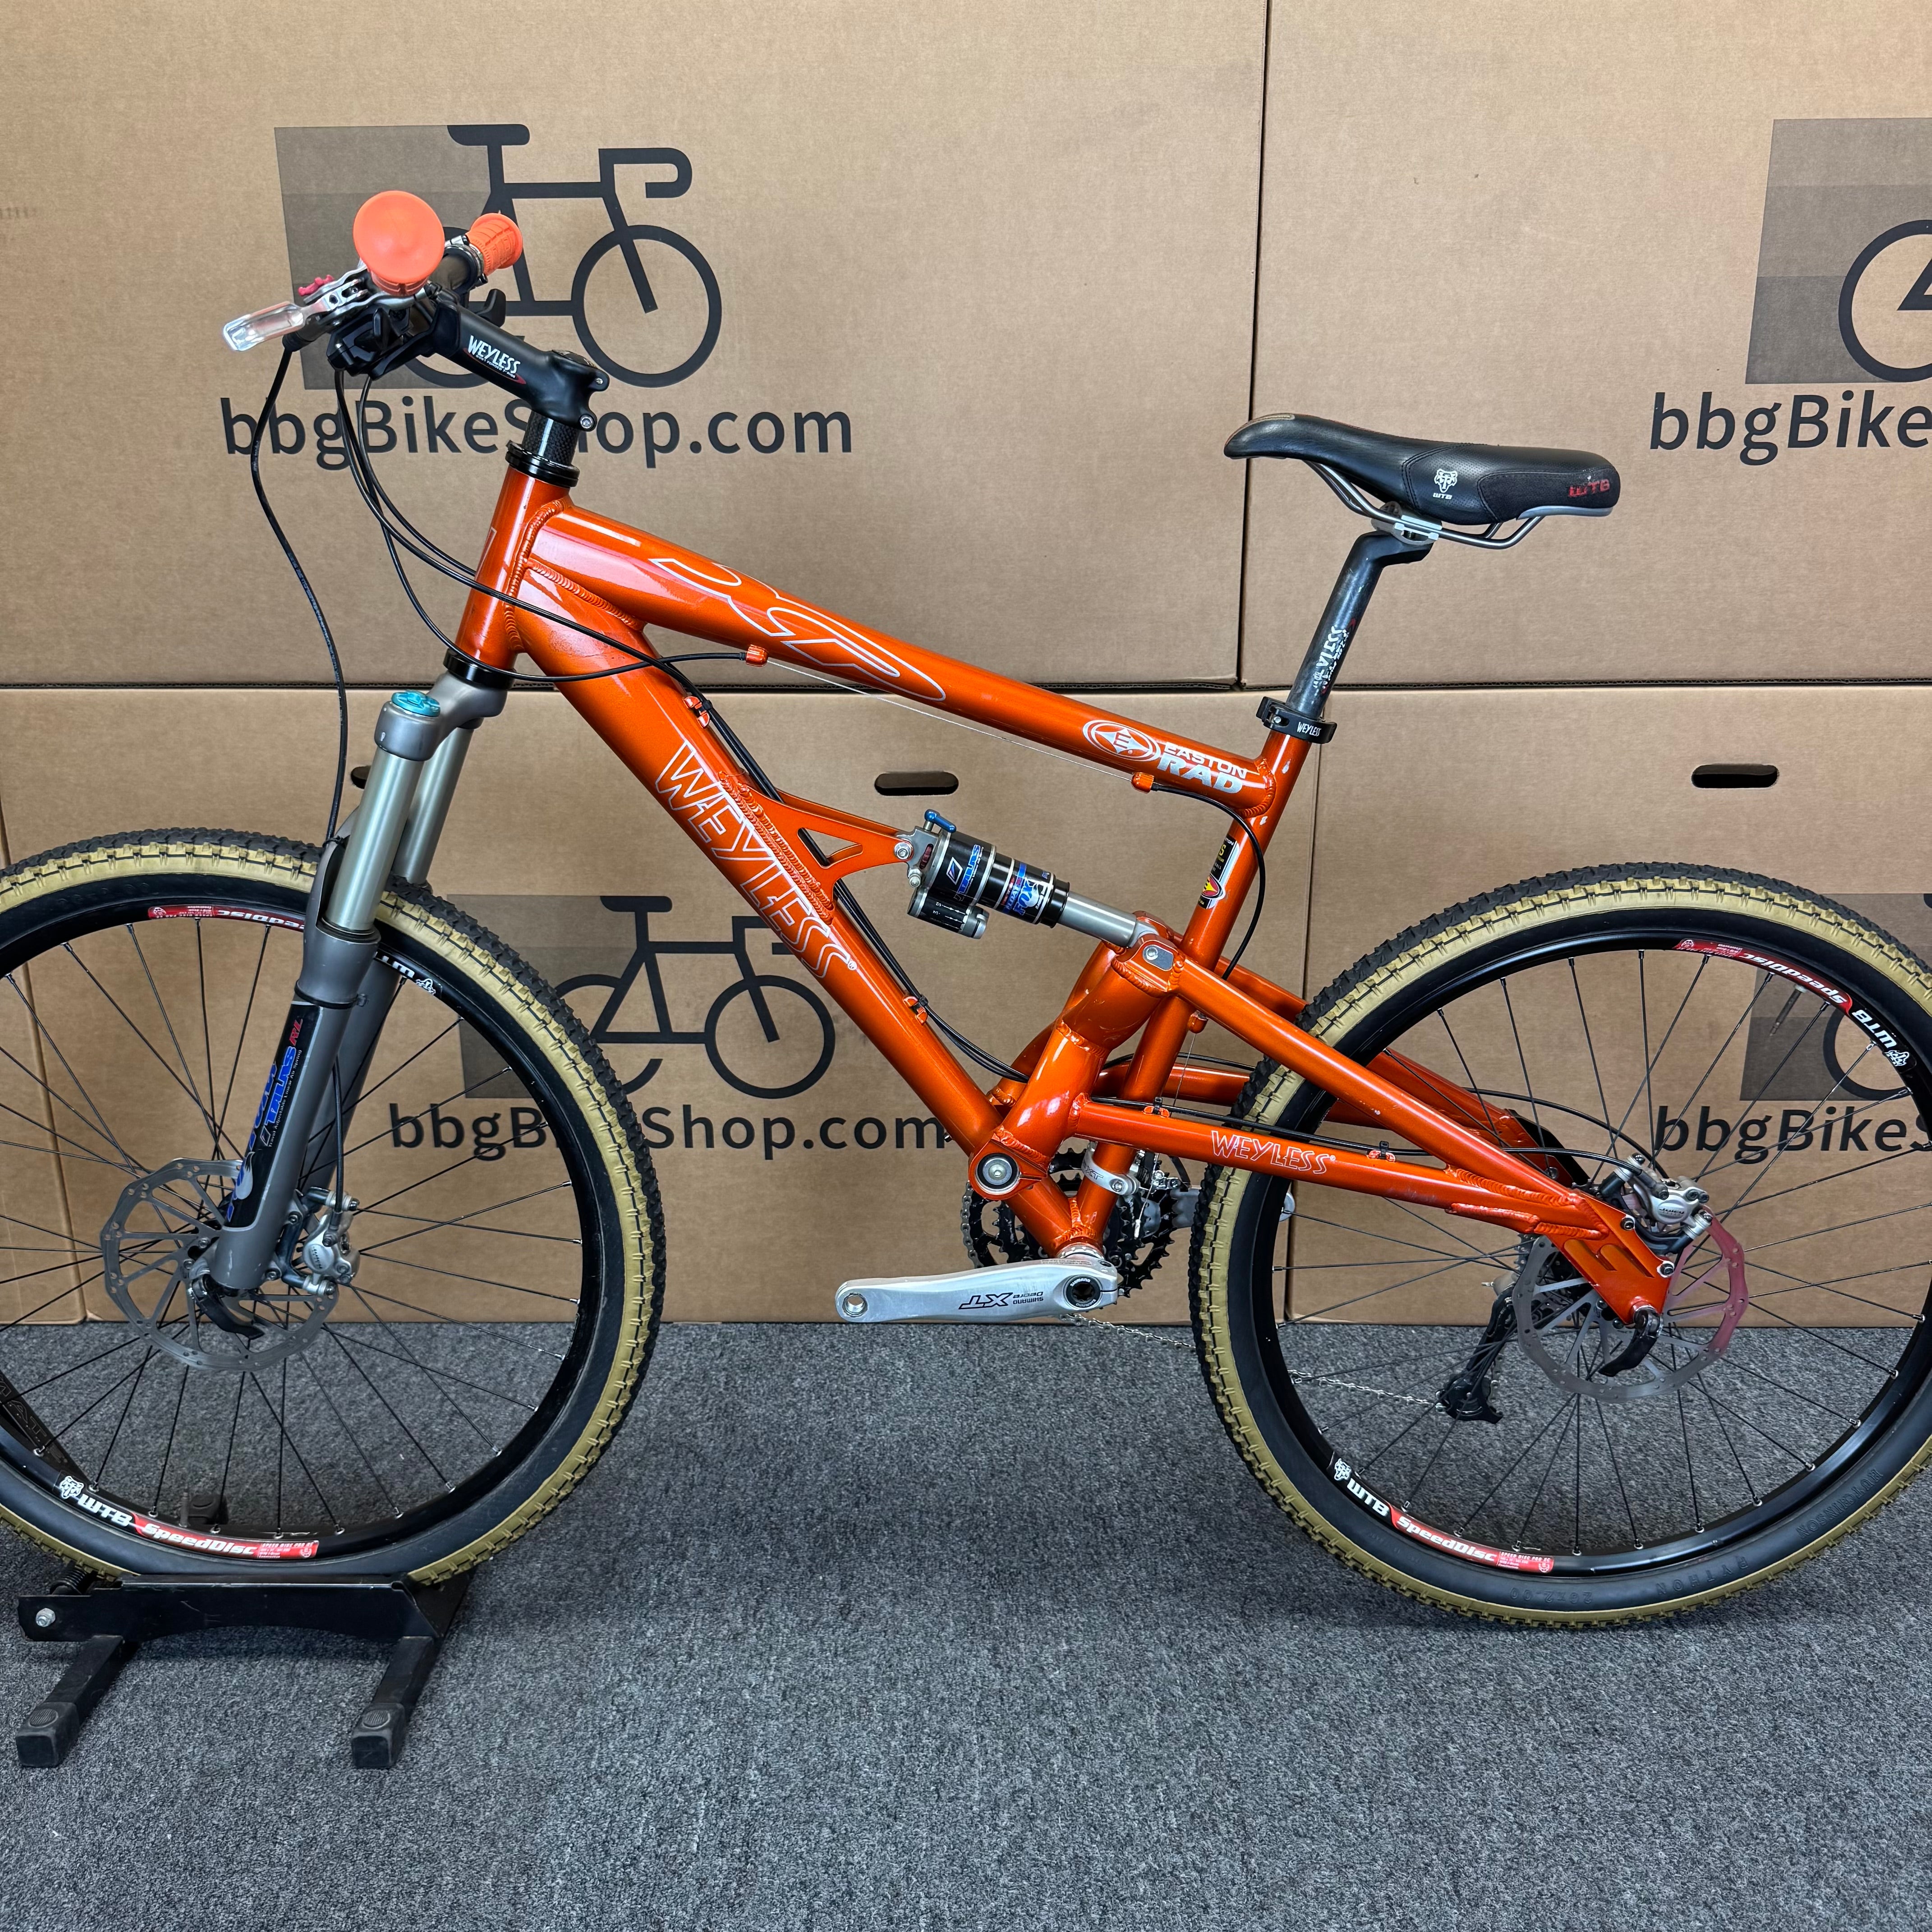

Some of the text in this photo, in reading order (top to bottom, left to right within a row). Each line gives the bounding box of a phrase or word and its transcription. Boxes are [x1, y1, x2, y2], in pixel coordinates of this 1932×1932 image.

[468, 335, 521, 374] WEYLESS
[221, 396, 852, 470] bbgBikeSop.com
[1568, 478, 1610, 498] WTB
[1297, 721, 1322, 737] WEYLESS
[1157, 752, 1243, 794] RAD
[1164, 741, 1249, 779] EASTON
[655, 740, 852, 979] WEYLESS
[956, 844, 981, 894] TALAS
[1005, 885, 1020, 910] FLOAT
[1012, 878, 1034, 916] FOX
[217, 909, 304, 929] edDisc
[1739, 952, 1849, 1006] SpeedDisc
[289, 1018, 303, 1047] RL
[1851, 1009, 1897, 1049] WTB
[264, 1046, 297, 1125] TALAS
[268, 1130, 277, 1147] Travel
[273, 1099, 287, 1130] Adjustable
[284, 1080, 293, 1098] Linear
[293, 1049, 302, 1069] Spring
[389, 1103, 945, 1161] bbgBShop.com
[1211, 1130, 1332, 1174] WEYLESS
[1086, 1168, 1104, 1181] XT
[958, 1292, 1013, 1310] XT
[1013, 1297, 1044, 1305] SHIMANO
[1070, 1278, 1091, 1287] SHIMANO
[78, 1494, 133, 1527] WTB
[1347, 1478, 1389, 1517] WTB
[143, 1523, 259, 1556] SpeedDisc
[1397, 1516, 1496, 1562] SpeedDisc
[1656, 1555, 1748, 1596] PYTHON
